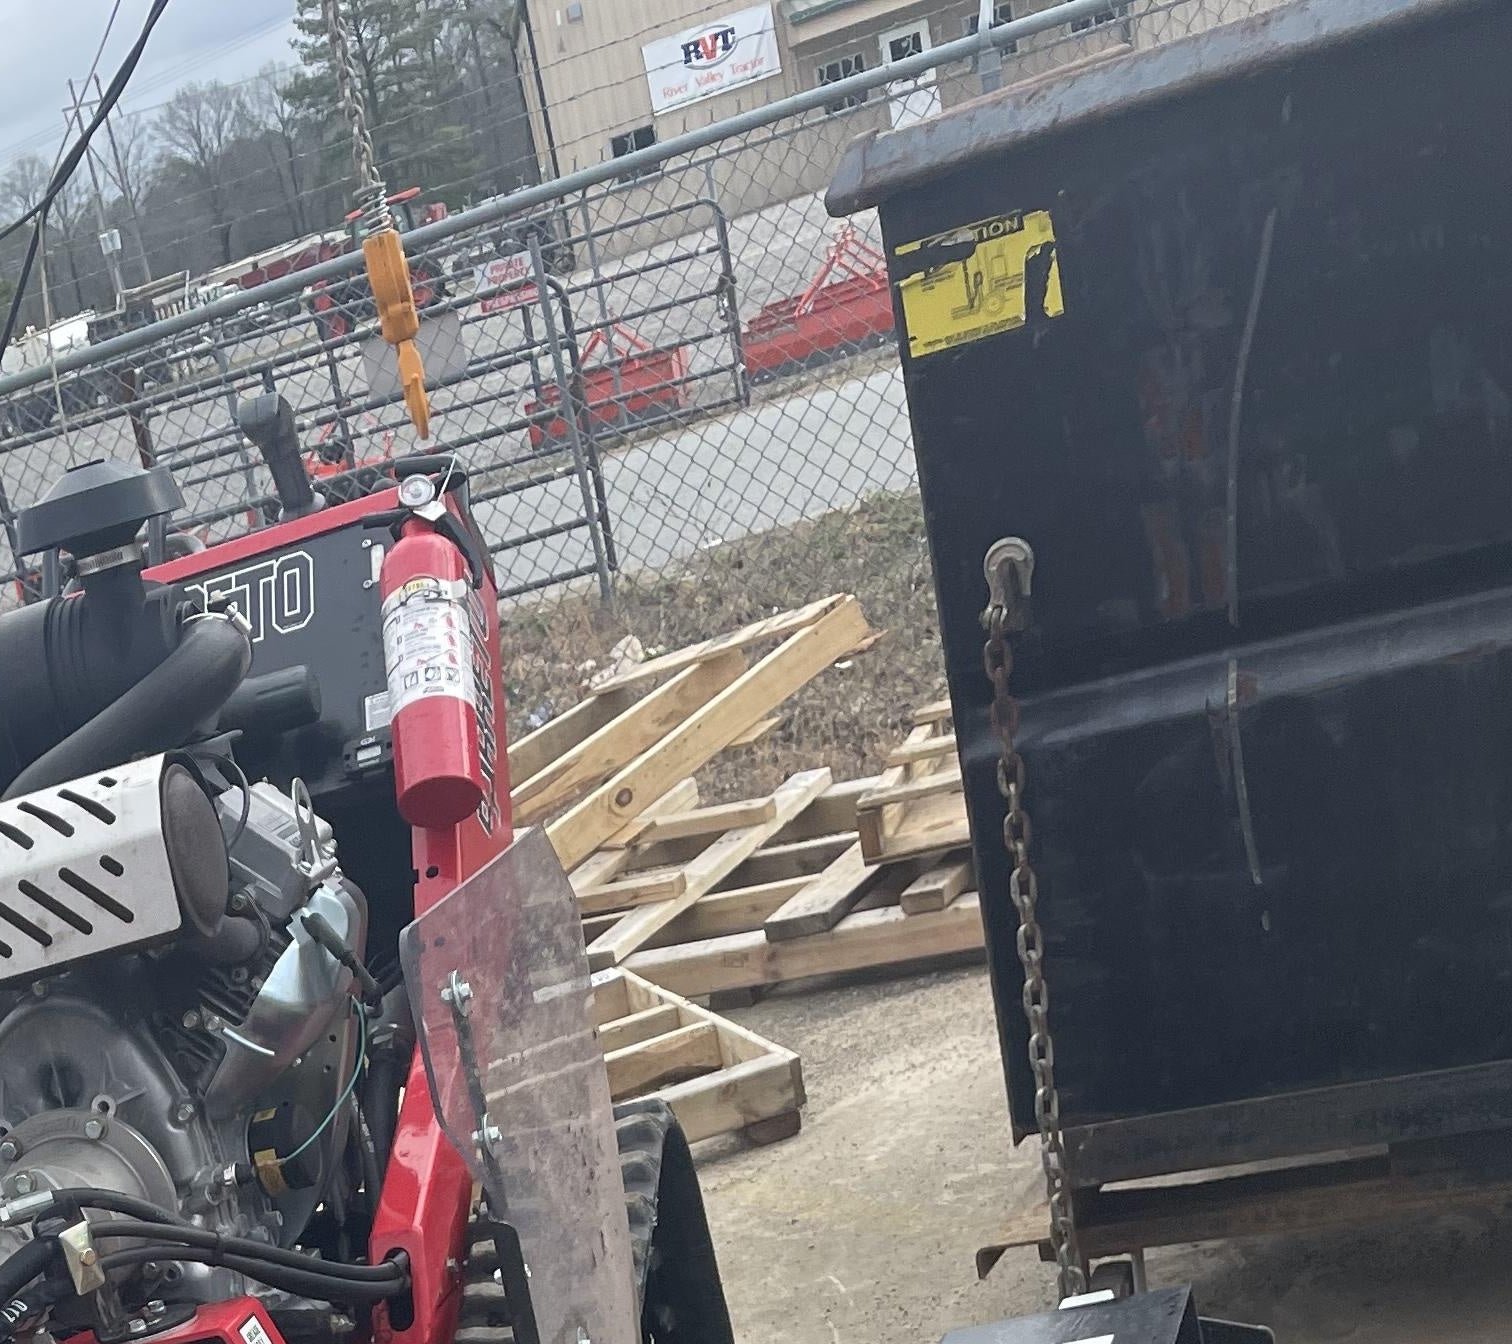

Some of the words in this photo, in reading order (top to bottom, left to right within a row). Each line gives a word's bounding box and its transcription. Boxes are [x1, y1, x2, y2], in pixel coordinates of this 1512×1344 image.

[681, 26, 735, 65] RVT
[663, 82, 688, 99] River
[694, 69, 724, 88] Valley
[730, 56, 765, 75] Tractor
